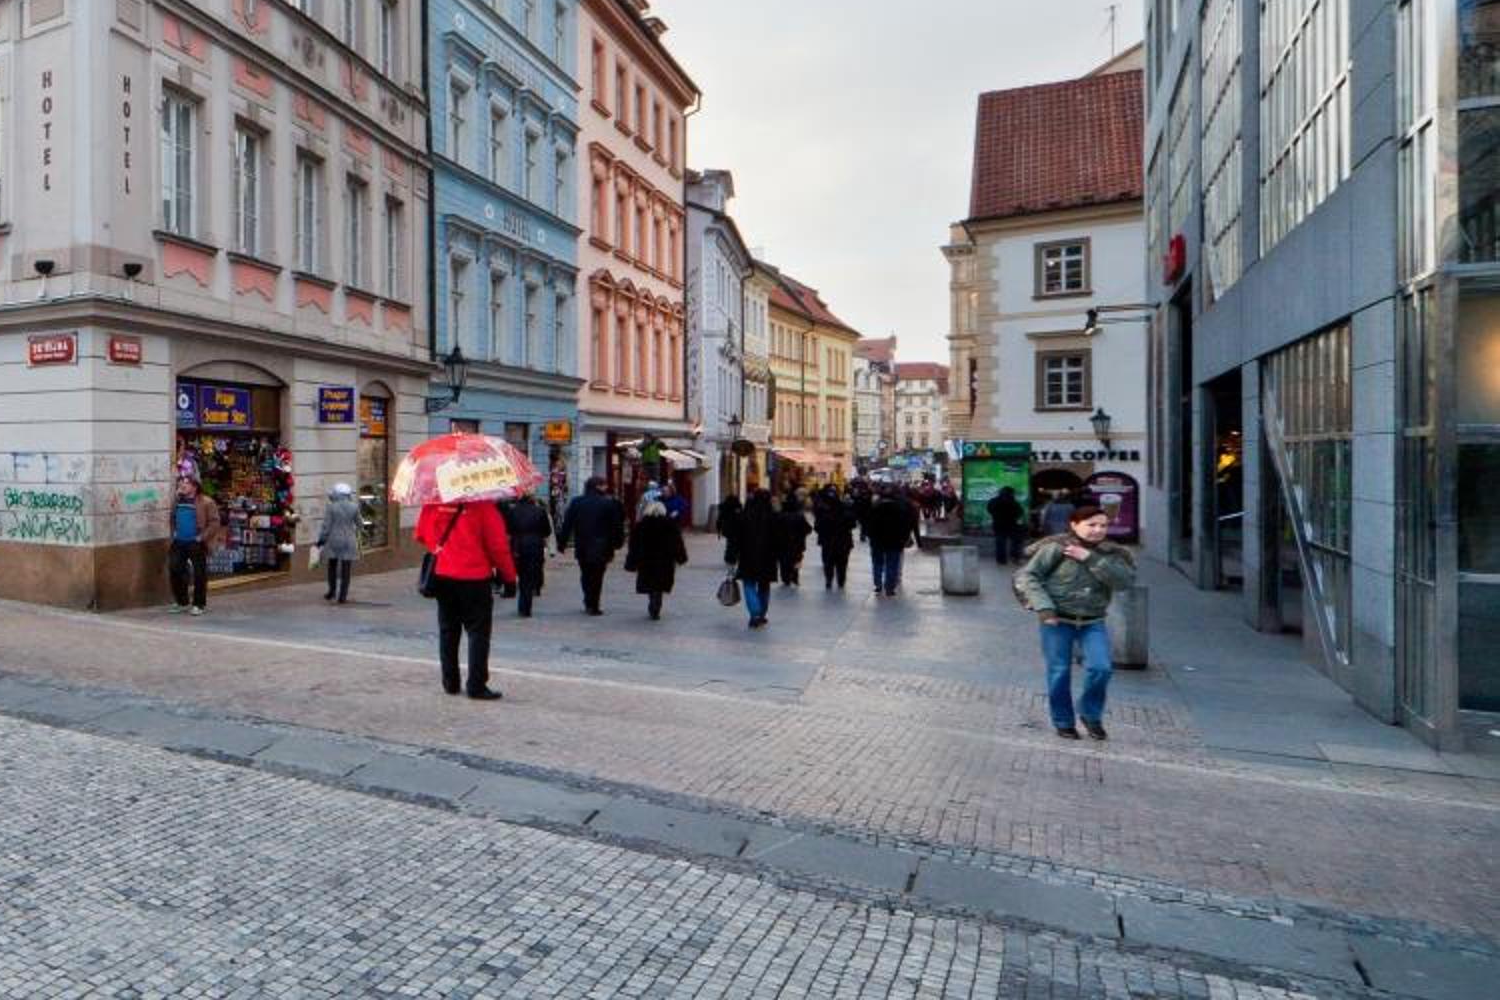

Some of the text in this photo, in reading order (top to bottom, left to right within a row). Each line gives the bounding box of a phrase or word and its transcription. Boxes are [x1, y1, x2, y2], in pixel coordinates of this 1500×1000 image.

[42, 70, 53, 191] HOTEL
[123, 74, 132, 196] HOTEL
[1070, 450, 1140, 461] COFFEE
